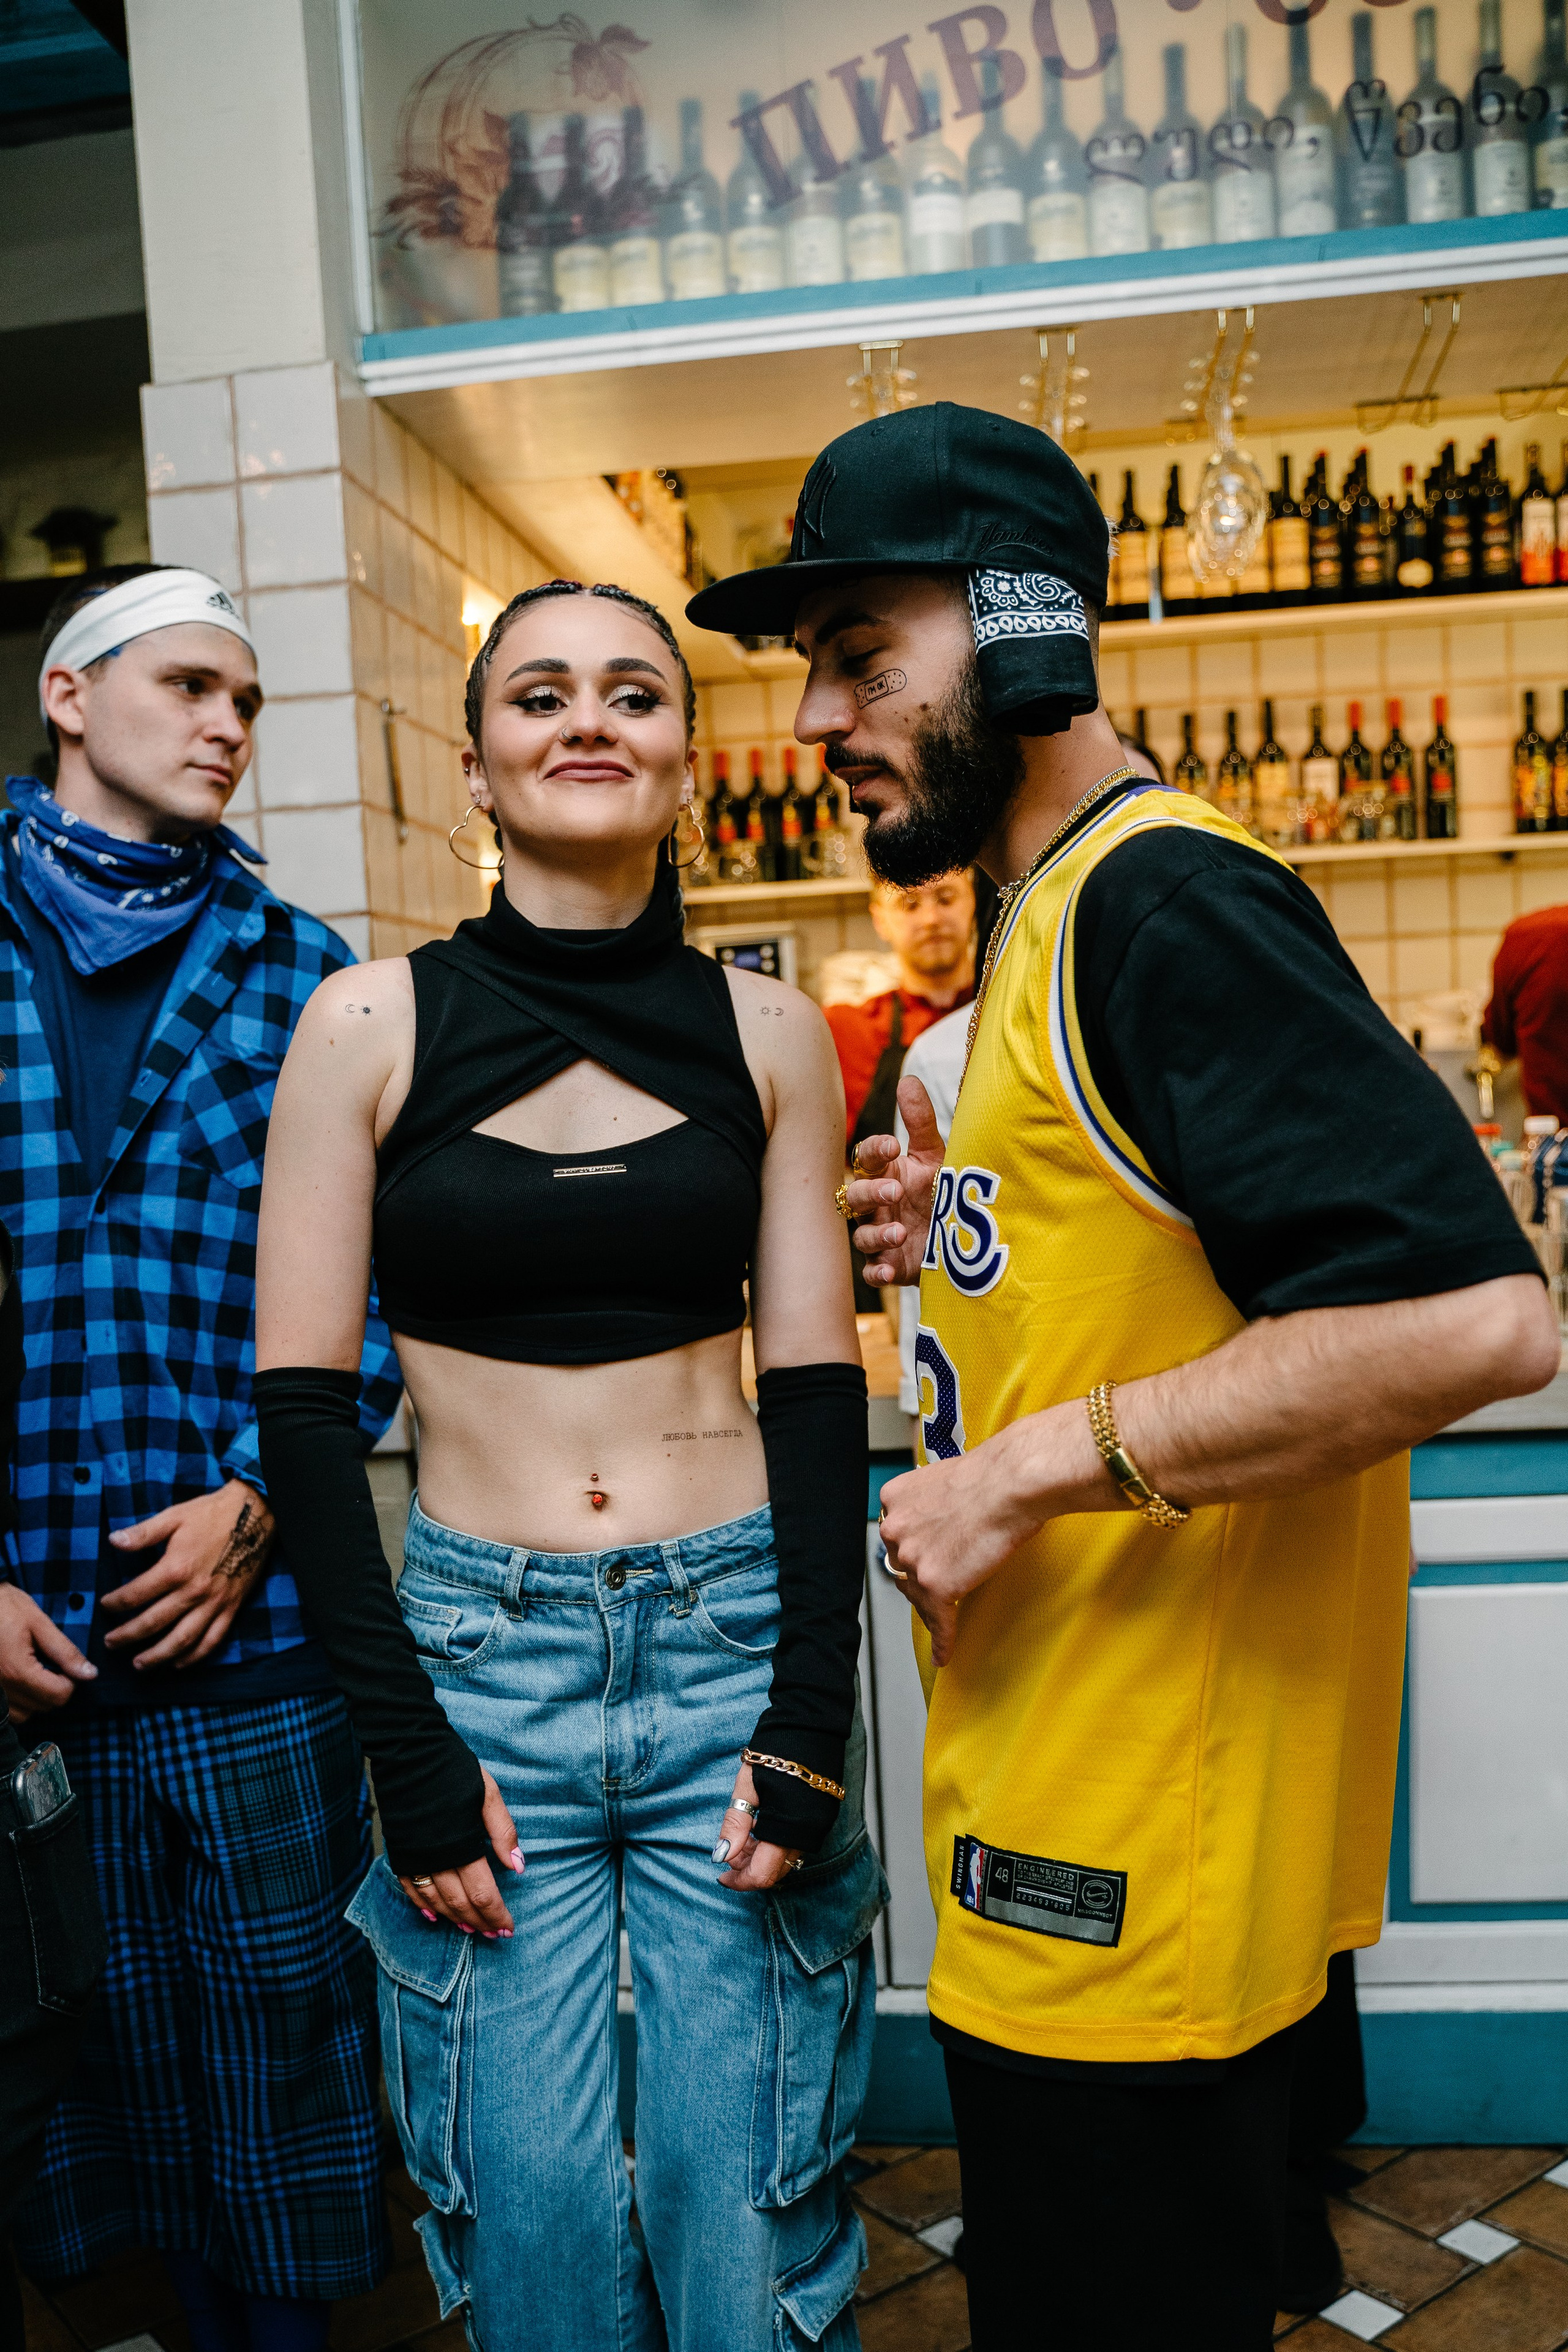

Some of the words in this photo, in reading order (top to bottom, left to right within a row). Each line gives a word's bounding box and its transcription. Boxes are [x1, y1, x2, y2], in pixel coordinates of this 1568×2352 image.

[877, 680, 886, 690] OK
[662, 1431, 697, 1442] ЛЮБОВЬ
[702, 1429, 743, 1439] НАВСЕГДА
[956, 1845, 965, 1889] SWINGMAN
[995, 1866, 1009, 1883] 48
[1017, 1863, 1074, 1880] ENGINEERED
